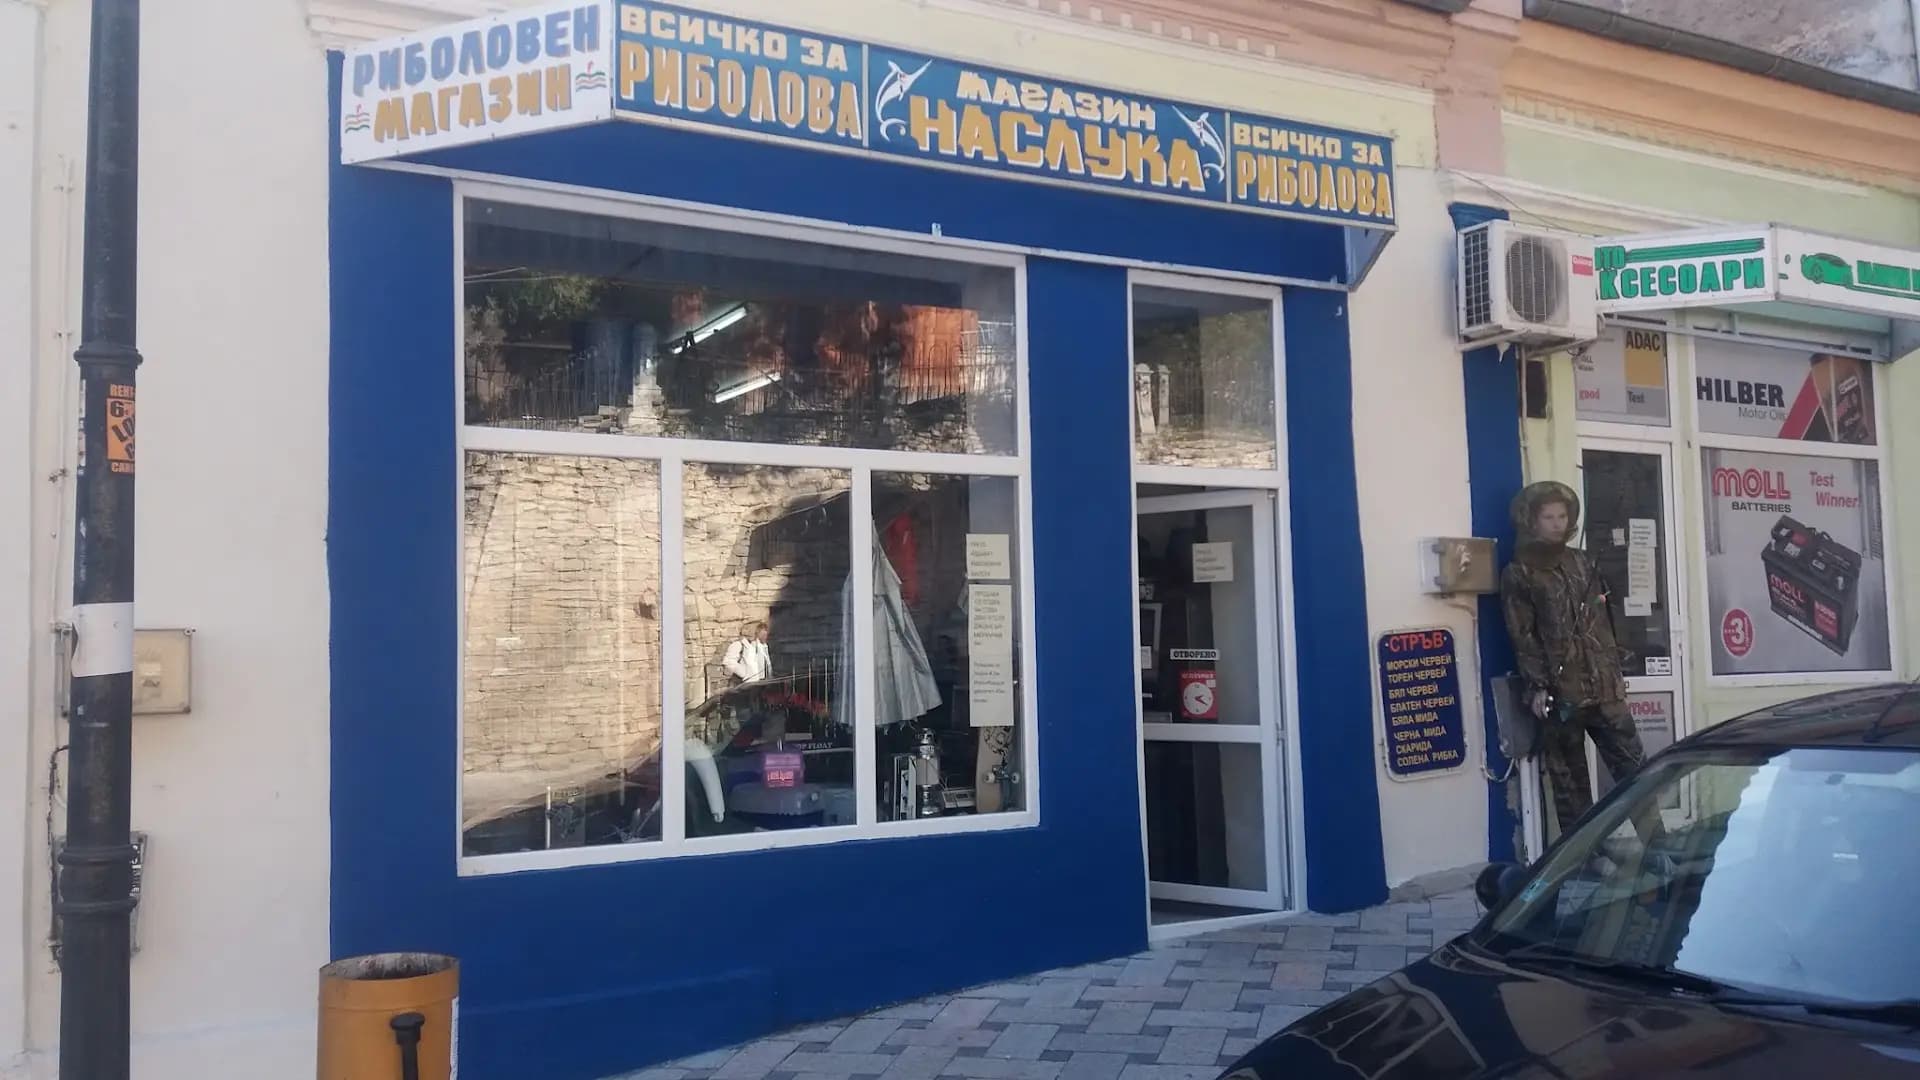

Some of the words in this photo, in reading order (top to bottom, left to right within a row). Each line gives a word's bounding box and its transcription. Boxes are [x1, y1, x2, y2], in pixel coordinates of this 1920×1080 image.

[353, 4, 600, 97] РИБОЛОВЕН
[620, 4, 787, 60] ВСИЧКО
[799, 39, 849, 72] ЗА
[373, 63, 572, 143] МАГАЗИН
[620, 40, 863, 140] РИБОЛОВА
[956, 70, 1157, 131] МАГАЗИН
[909, 95, 1207, 192] НАСЛУКА
[1233, 122, 1343, 160] ВСИЧКО
[1351, 141, 1384, 167] ЗА
[1236, 151, 1395, 219] РИБОЛОВА
[1596, 257, 1765, 300] КСЕСОАРИ
[1625, 330, 1662, 352] ADAC
[1696, 376, 1786, 408] HILBER
[1738, 407, 1768, 420] Motor
[1713, 467, 1792, 499] MOLL
[1809, 471, 1835, 488] Test
[1731, 501, 1792, 514] BATTERIES
[1389, 632, 1444, 652] СТРЪВ
